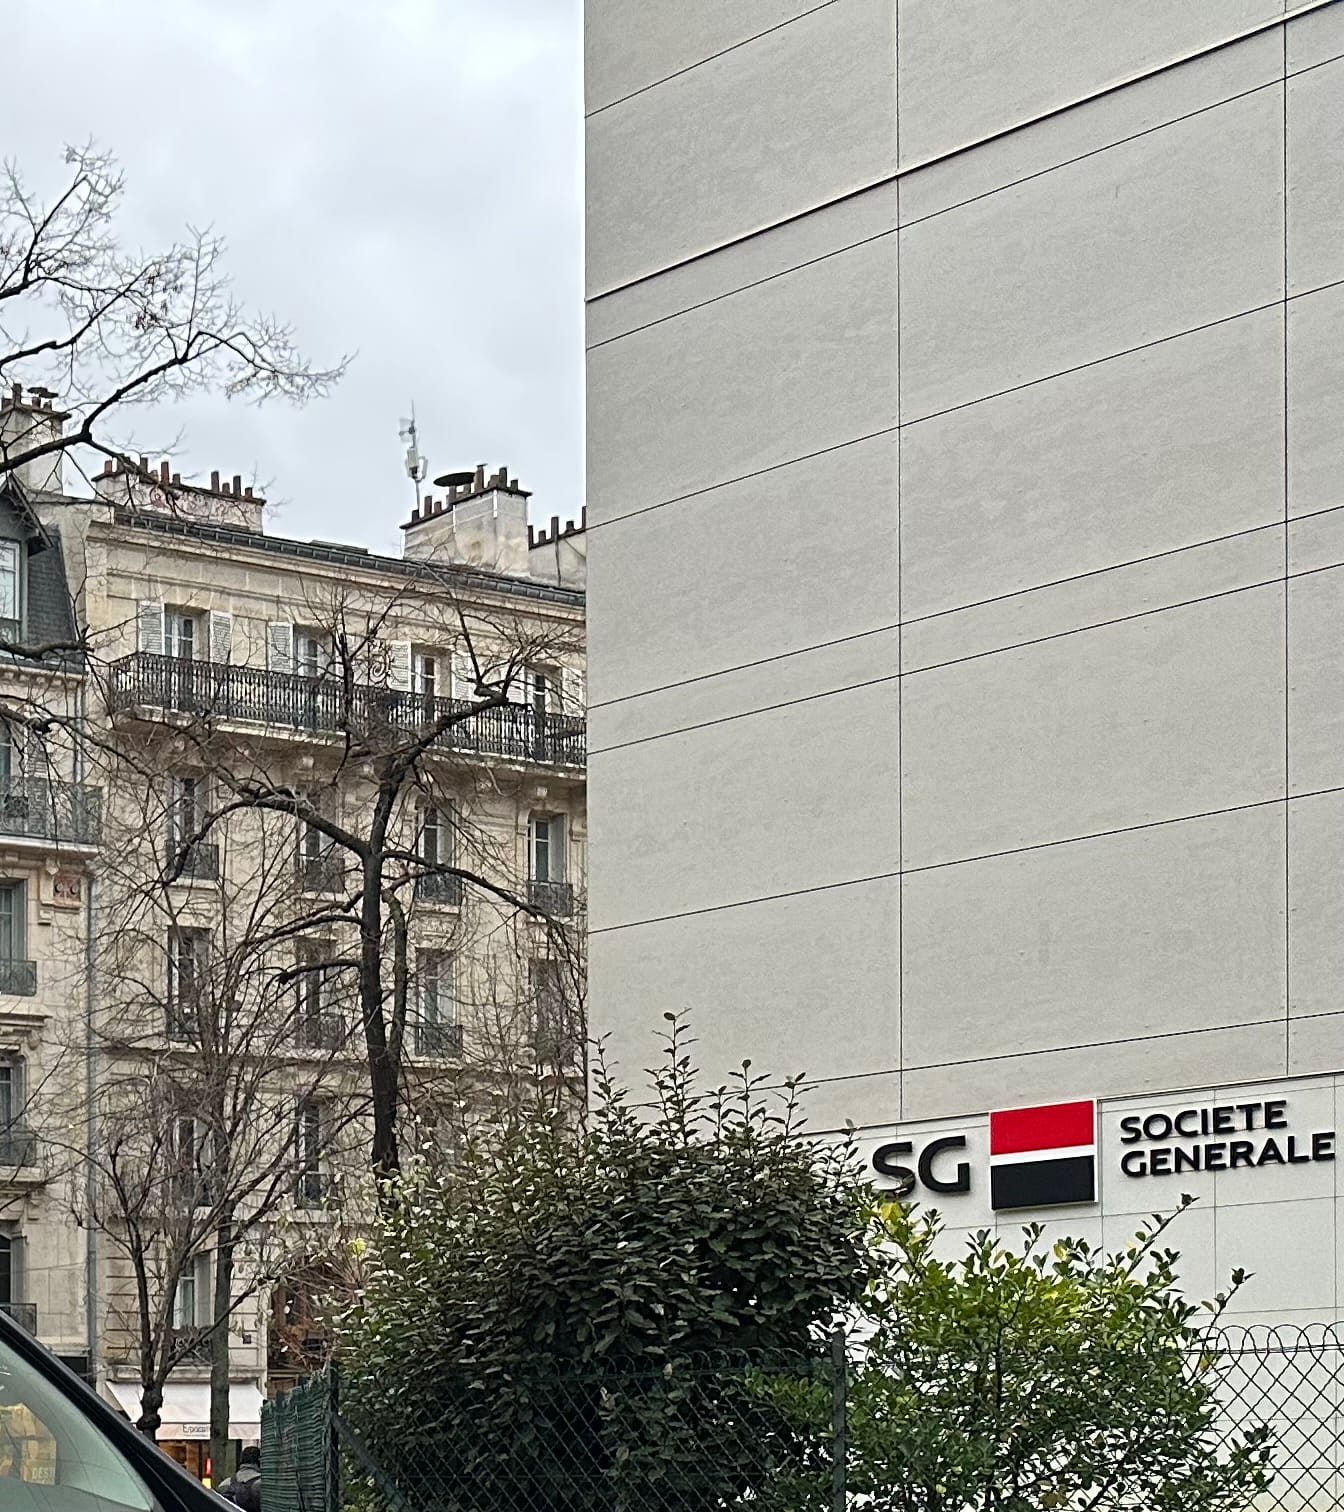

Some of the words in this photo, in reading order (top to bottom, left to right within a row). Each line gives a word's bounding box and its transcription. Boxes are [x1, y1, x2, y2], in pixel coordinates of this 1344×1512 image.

[1120, 1099, 1288, 1144] SOCIETE
[871, 1135, 971, 1197] SG
[1120, 1131, 1336, 1178] GENERALE
